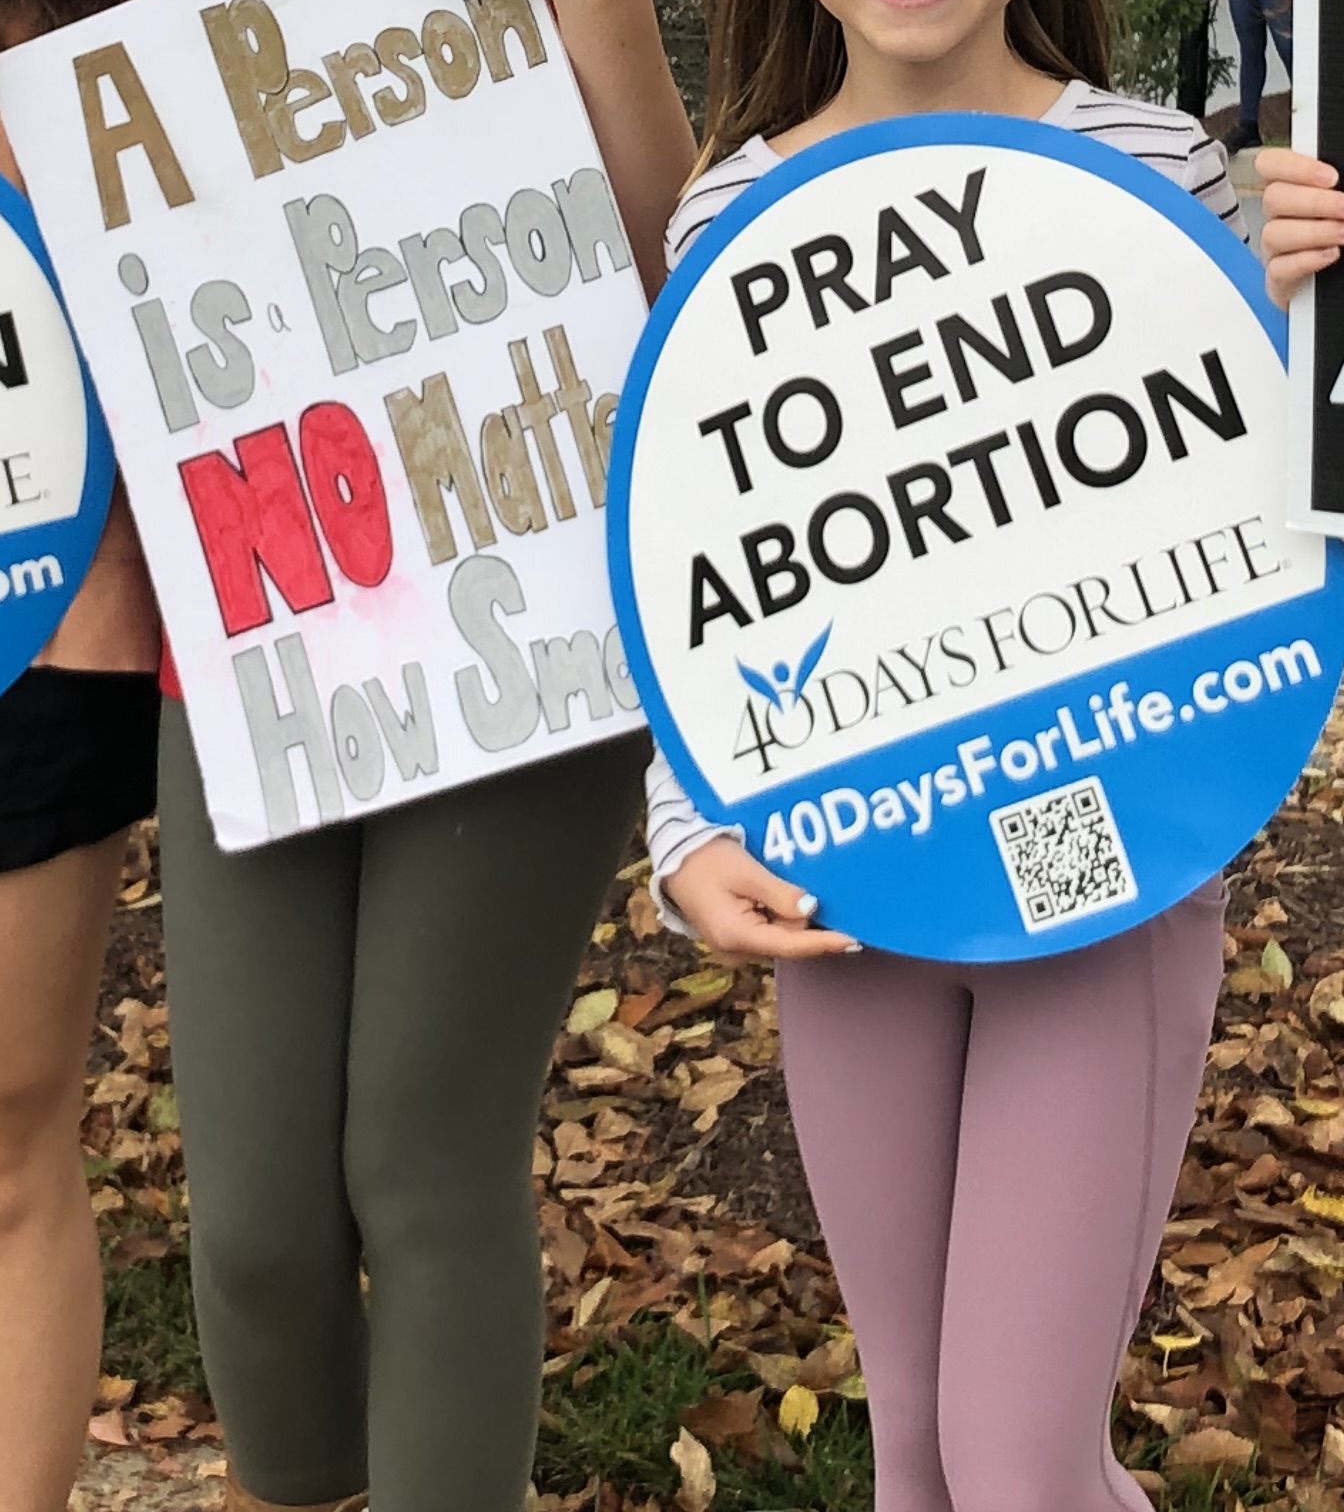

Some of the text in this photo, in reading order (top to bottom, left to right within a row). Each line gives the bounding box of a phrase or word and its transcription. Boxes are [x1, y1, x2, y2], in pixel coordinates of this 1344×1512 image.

[73, 40, 196, 231] A
[118, 167, 632, 433] is a Person
[730, 167, 988, 357] PRAY
[698, 269, 1113, 494] TO END
[178, 401, 394, 638] NO
[688, 348, 1249, 650] ABORTION
[232, 632, 440, 839] How
[762, 637, 1323, 866] 40DaysForLife.com
